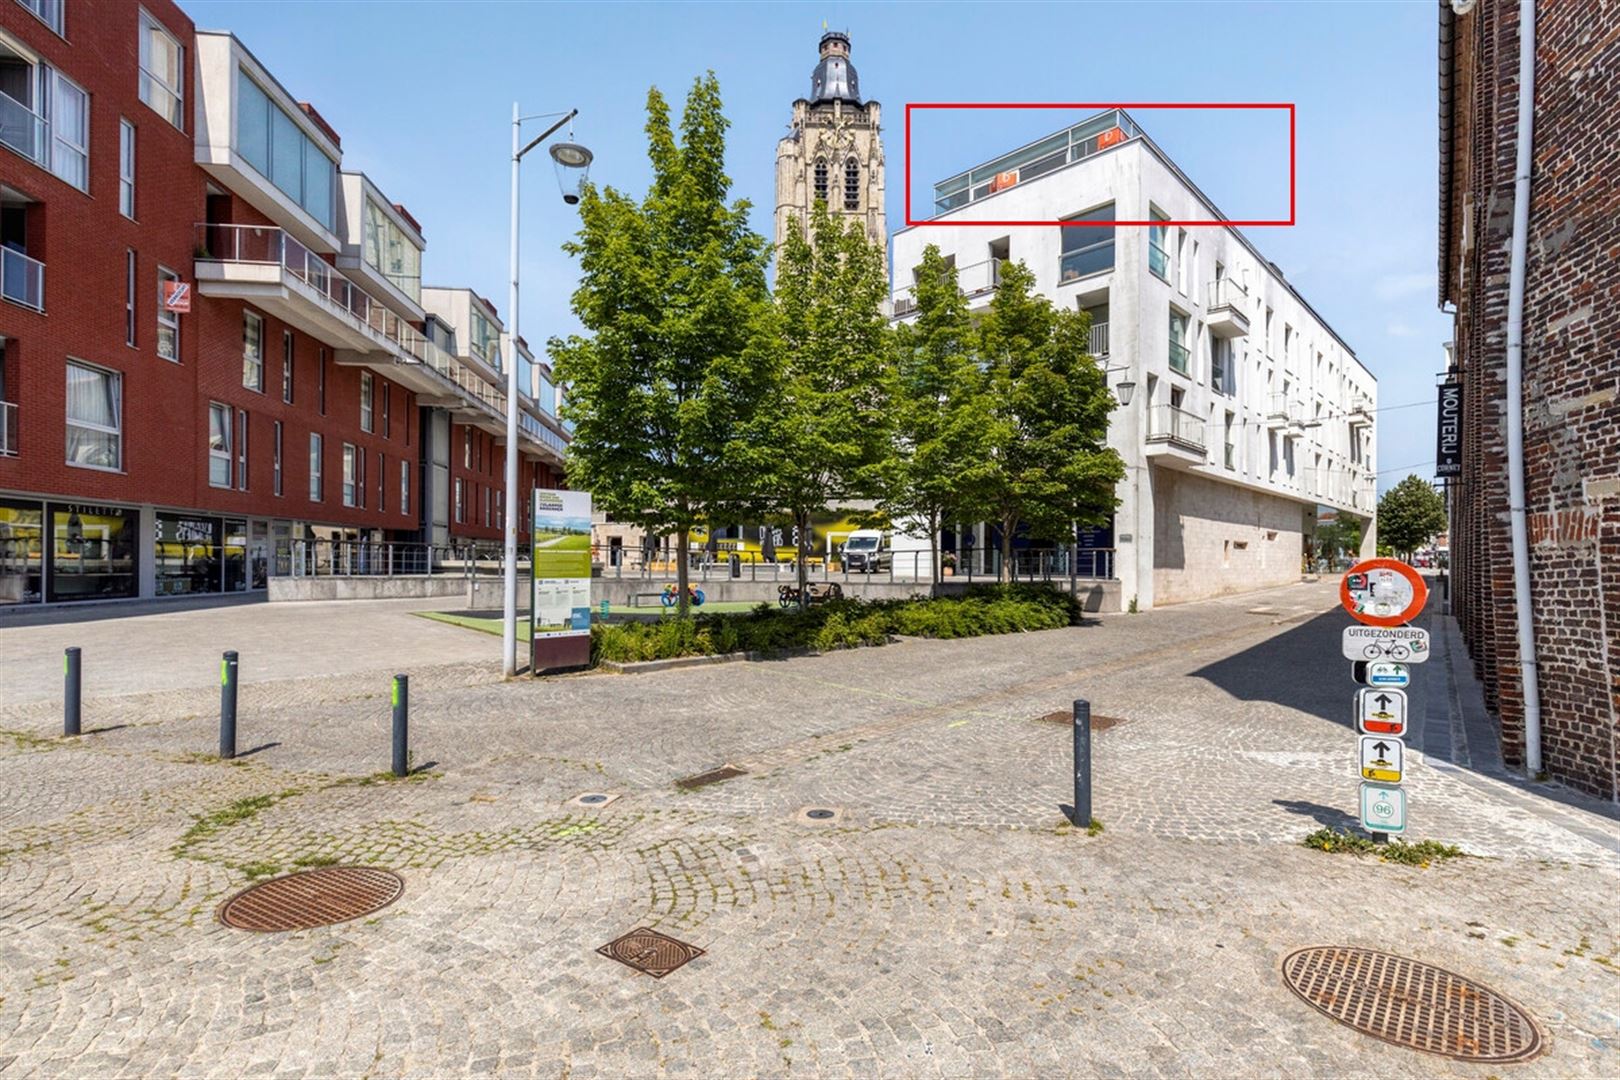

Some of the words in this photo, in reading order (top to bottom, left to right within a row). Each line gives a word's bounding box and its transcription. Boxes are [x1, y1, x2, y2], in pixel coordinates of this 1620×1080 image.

[1442, 388, 1458, 454] MOUTERIJ
[1348, 628, 1424, 639] UITGEZONDERD
[1375, 804, 1391, 815] 96
